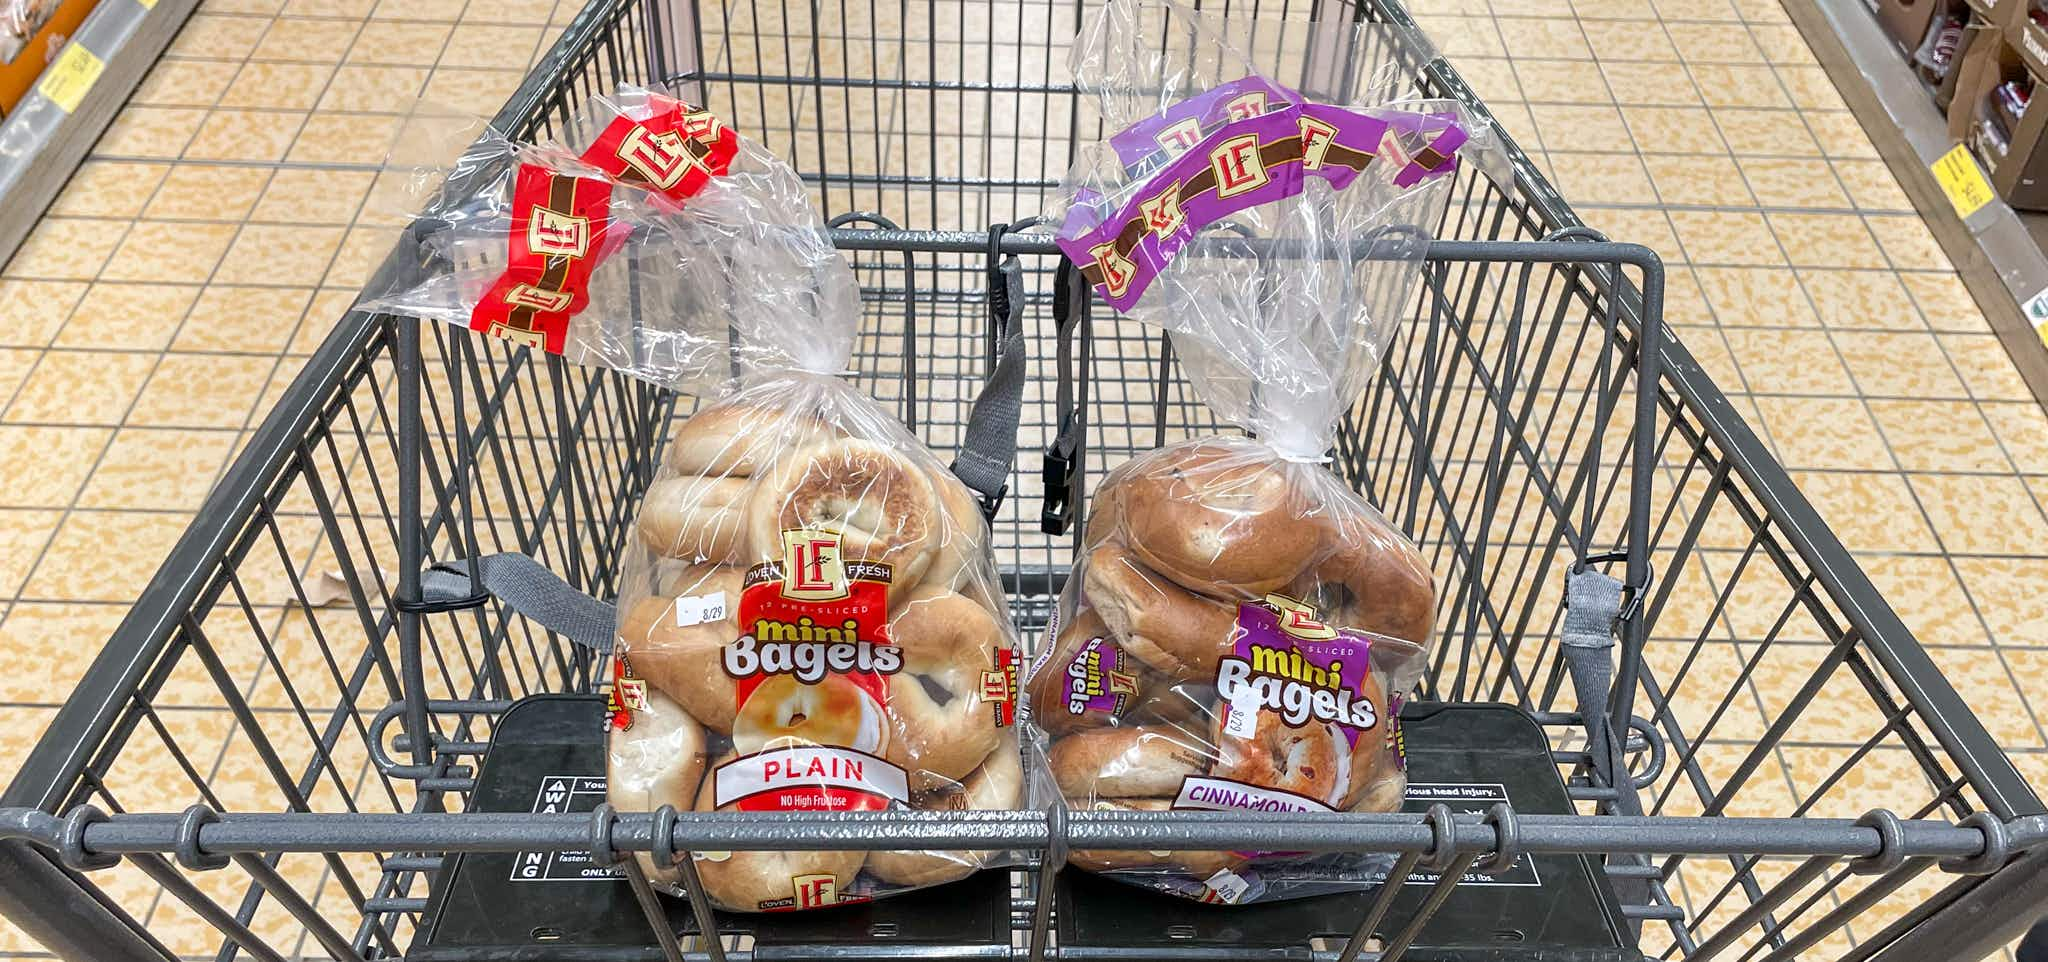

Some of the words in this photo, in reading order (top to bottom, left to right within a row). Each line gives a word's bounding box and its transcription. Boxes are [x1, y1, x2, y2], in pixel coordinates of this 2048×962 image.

[1218, 140, 1257, 191] LF
[792, 539, 838, 592] LF
[847, 564, 891, 578] FRESH
[702, 605, 723, 621] 8/29
[781, 602, 869, 615] PRE-SLICED
[755, 617, 858, 642] mini
[724, 636, 901, 682] Bagels
[1251, 645, 1342, 690] mini
[1068, 638, 1102, 714] Bagels
[1087, 651, 1105, 696] mini
[1217, 658, 1376, 728] Bagels
[1230, 710, 1245, 733] 8/29
[763, 756, 864, 784] PLAIN
[780, 795, 793, 806] NO
[794, 795, 812, 808] High
[1432, 788, 1460, 796] head
[559, 853, 588, 863] fasten
[581, 868, 612, 877] ONLY
[799, 878, 833, 909] LF
